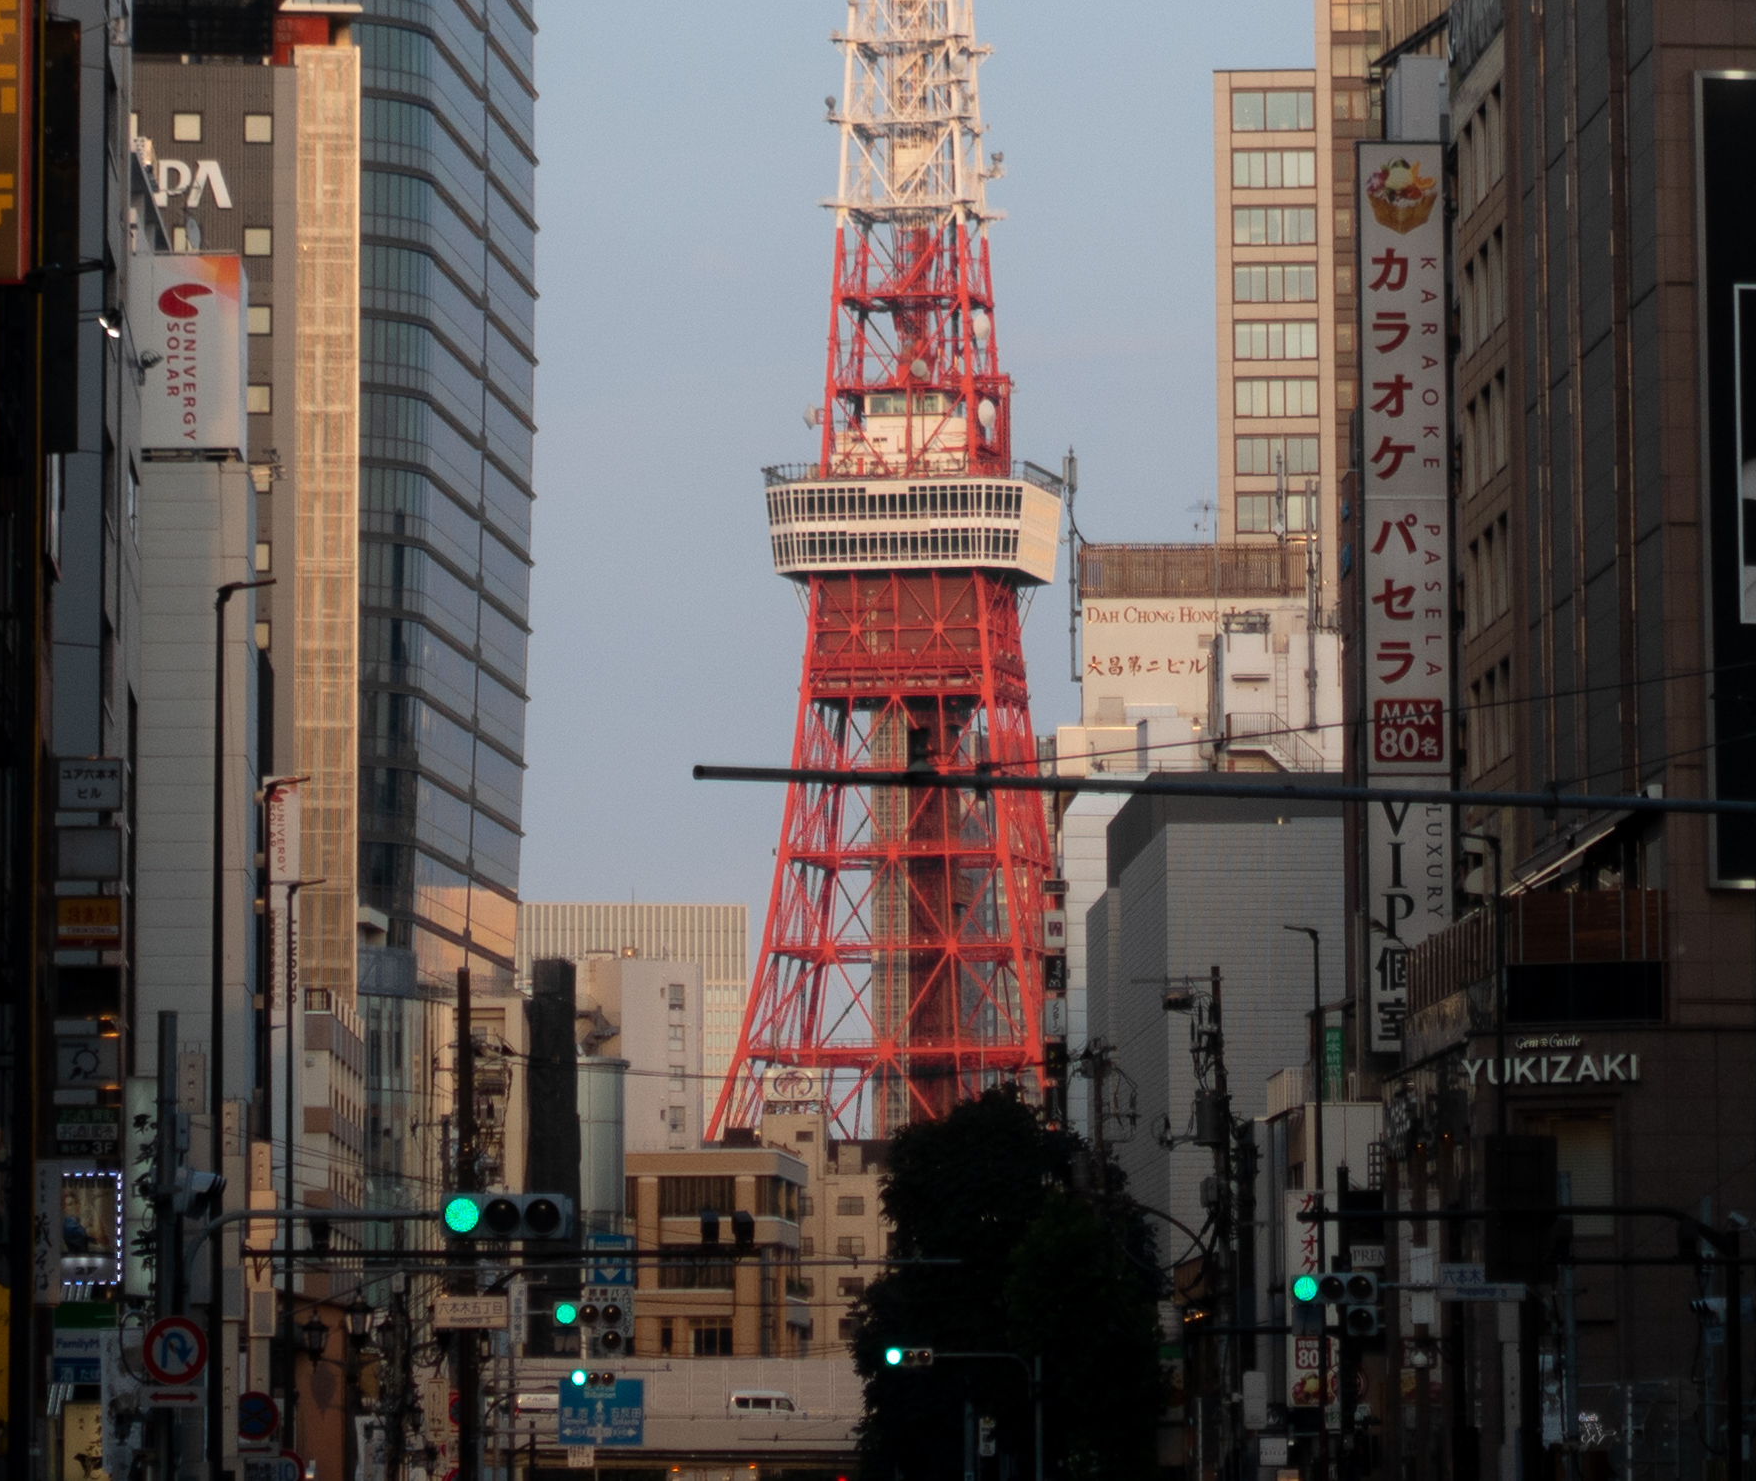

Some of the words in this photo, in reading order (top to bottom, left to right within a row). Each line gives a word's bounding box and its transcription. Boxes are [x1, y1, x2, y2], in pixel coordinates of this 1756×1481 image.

[166, 321, 180, 398] SOLAR
[1368, 248, 1416, 481] カラオケ
[1419, 256, 1441, 470] KARAOKE
[182, 321, 197, 441] UNIVERGY
[1370, 513, 1418, 685] パセラ
[1423, 524, 1443, 677] PASELA
[1086, 606, 1119, 624] DAH
[1123, 606, 1175, 624] CHONG
[1178, 606, 1221, 624] HONG
[1087, 655, 1208, 677] 大昌第二ビル
[1378, 702, 1436, 726] MAX
[1379, 727, 1439, 759] 80名
[61, 769, 119, 781] ユア六本木
[76, 787, 102, 799] ビル
[1425, 803, 1444, 918] LUXURY
[1548, 1033, 1581, 1049] Castle
[1460, 1054, 1638, 1086] YUKIZAKI
[92, 1141, 114, 1155] 3F
[1456, 1287, 1495, 1298] Roppongi
[438, 1301, 504, 1315] 六本木五丁目
[610, 1407, 641, 1418] 五反田
